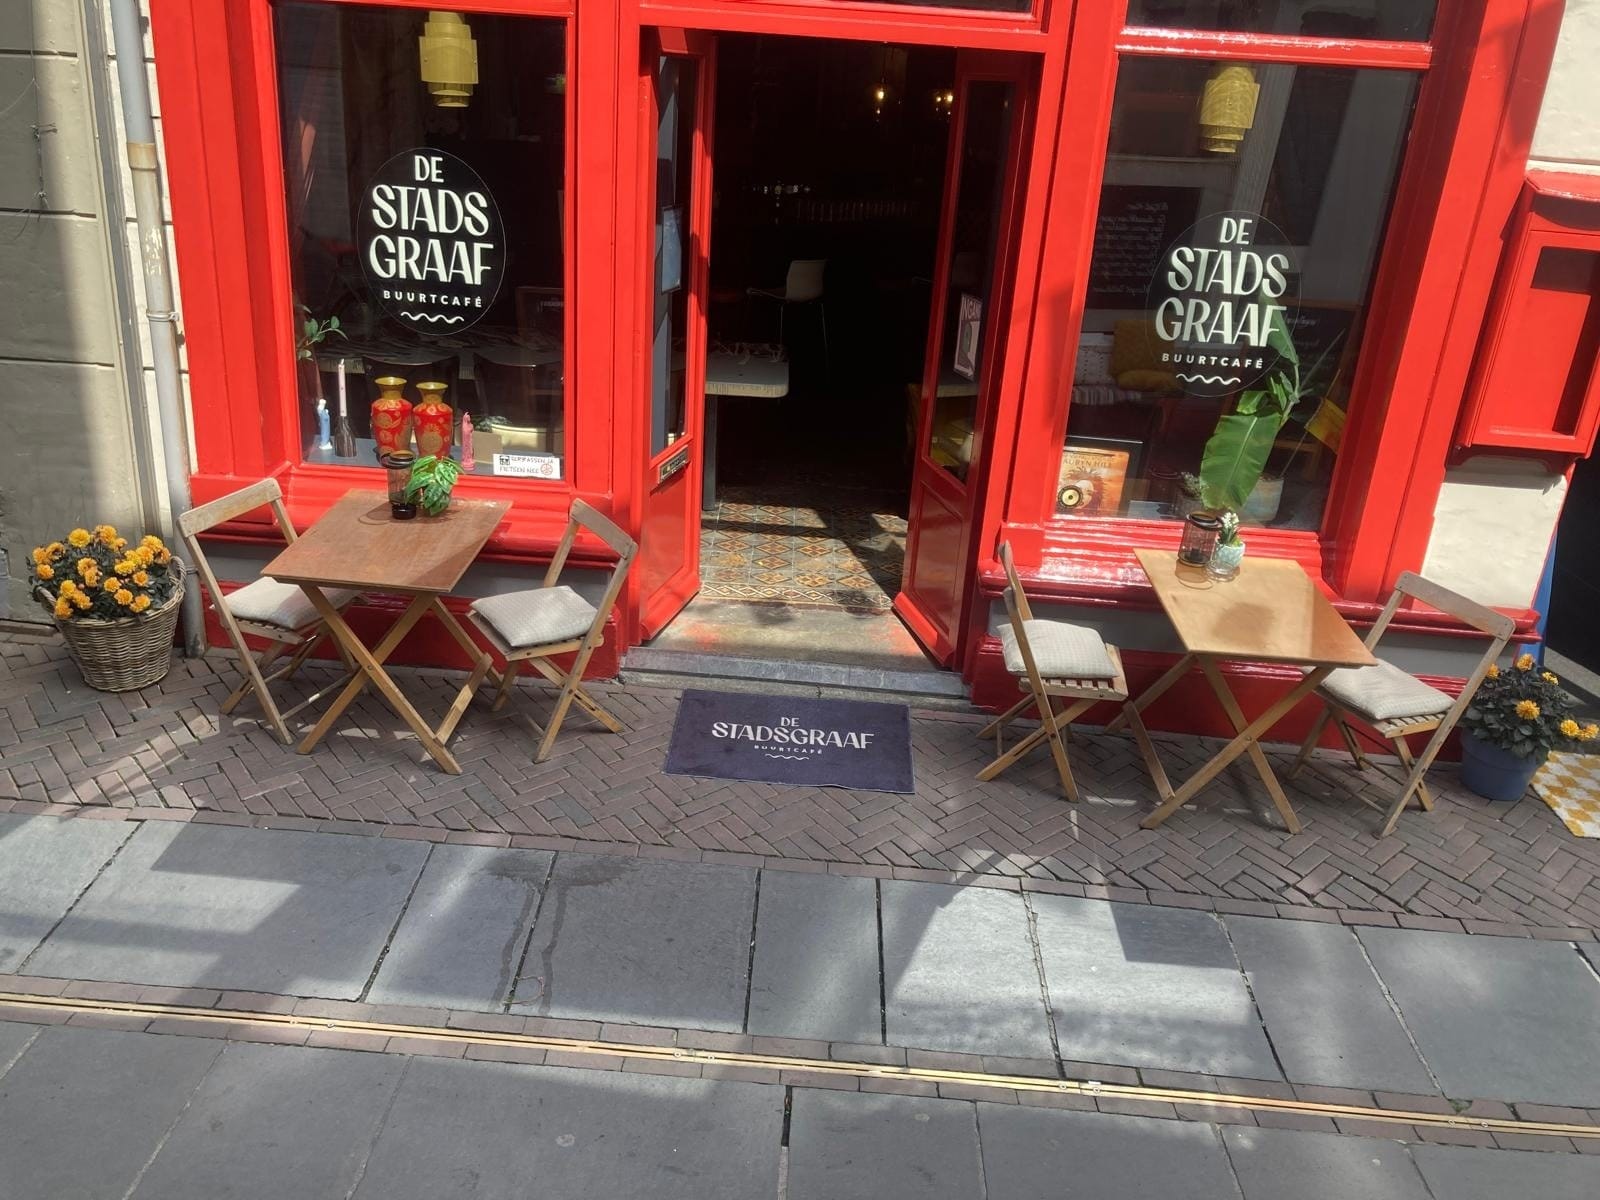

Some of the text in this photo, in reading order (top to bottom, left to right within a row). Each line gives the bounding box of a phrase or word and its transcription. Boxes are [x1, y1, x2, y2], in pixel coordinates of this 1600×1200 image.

[414, 154, 445, 183] DE
[372, 184, 490, 236] STADS
[1219, 217, 1252, 245] DE
[369, 234, 494, 285] GRAAF
[1167, 246, 1289, 298] STADS
[383, 290, 482, 308] BUURTCAFÉ
[1155, 297, 1287, 347] GRAAF
[1161, 352, 1263, 369] BUURTCAFÉ
[711, 721, 875, 749] STADSGRAAF
[780, 716, 800, 727] DE
[754, 745, 823, 754] BUURTCAFÉ
